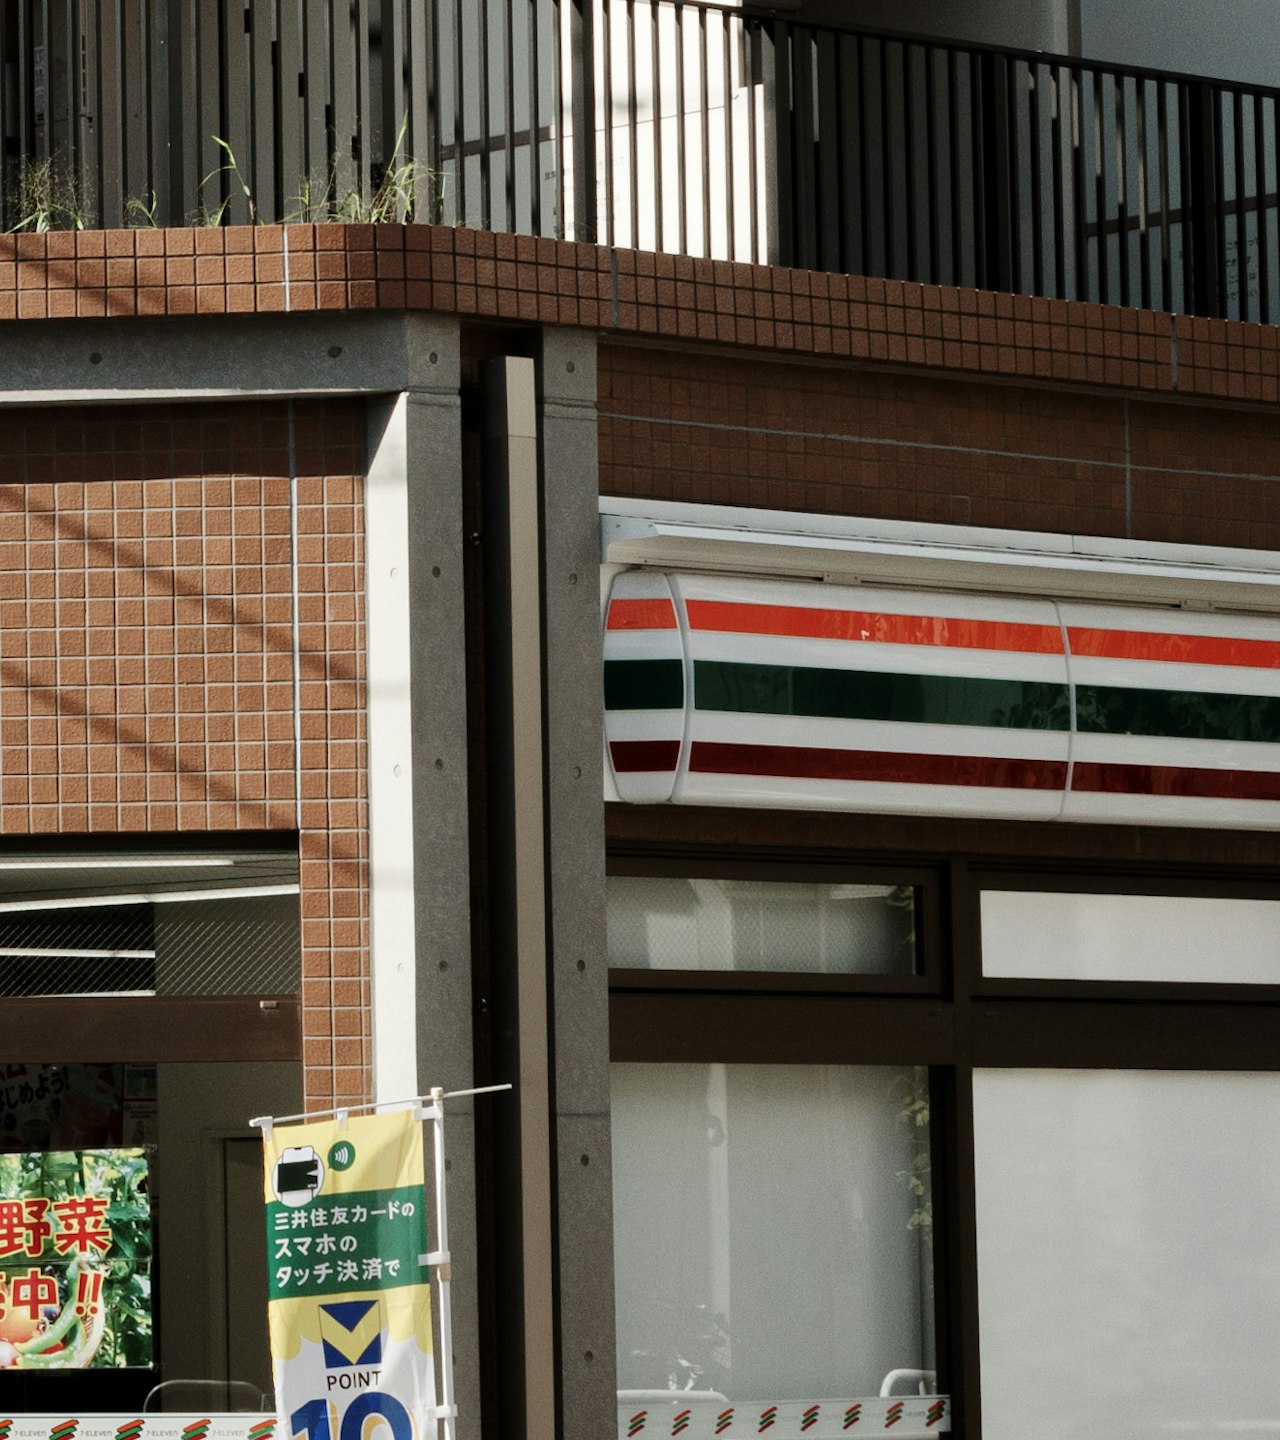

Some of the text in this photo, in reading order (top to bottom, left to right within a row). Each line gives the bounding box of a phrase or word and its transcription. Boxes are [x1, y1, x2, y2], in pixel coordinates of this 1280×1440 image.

[274, 1200, 416, 1231] 三井住友カードの
[274, 1232, 358, 1260] スマホの
[275, 1258, 401, 1289] タッチ決済で
[326, 1370, 382, 1391] POINT
